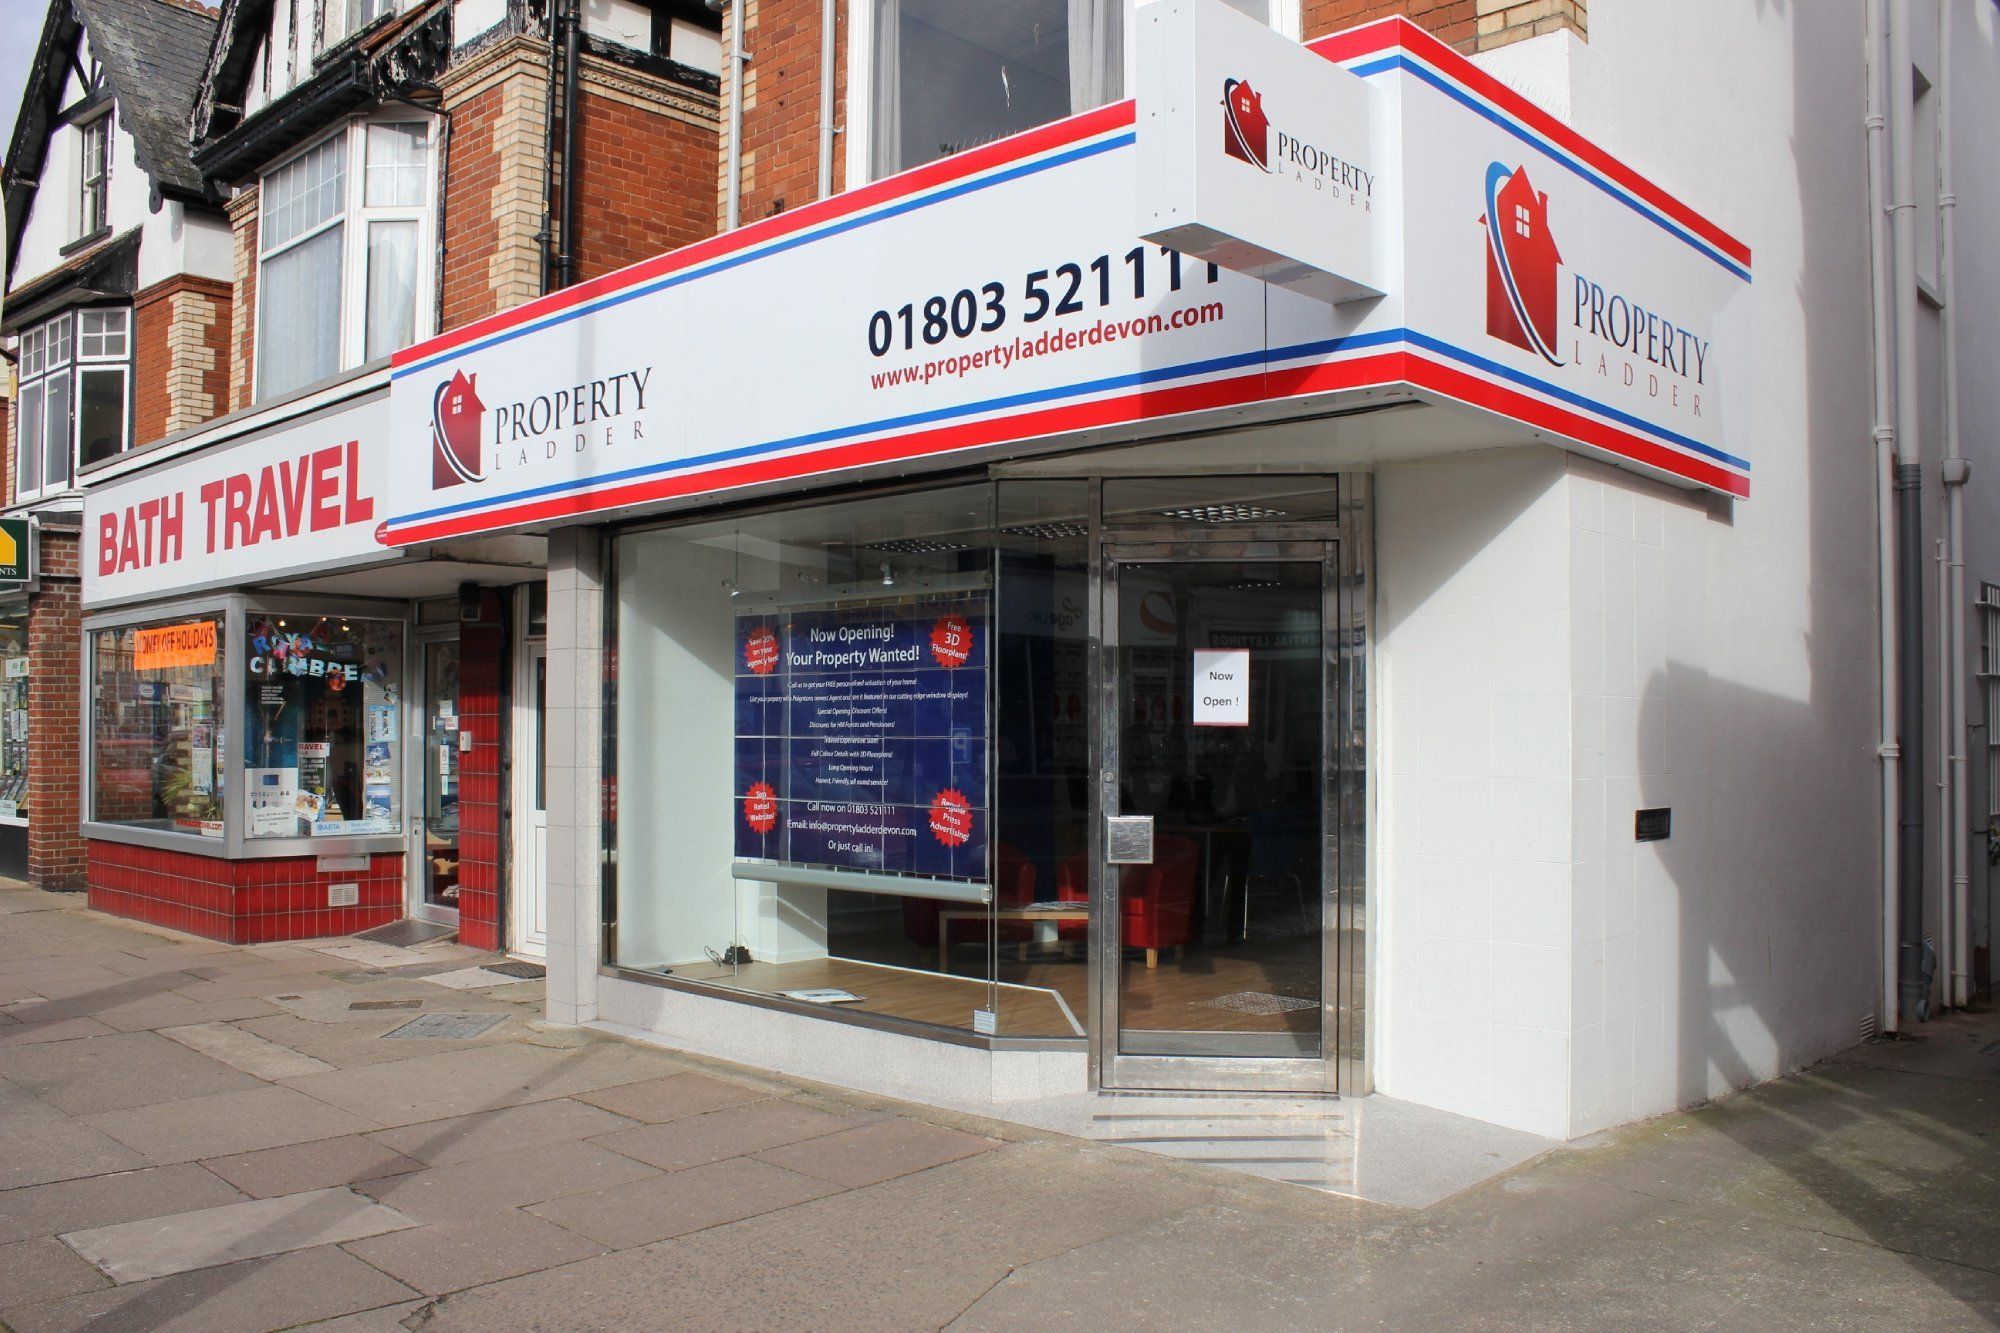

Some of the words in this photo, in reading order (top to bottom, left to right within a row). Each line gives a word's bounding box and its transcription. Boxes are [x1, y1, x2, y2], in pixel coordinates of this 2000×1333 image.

[1278, 131, 1375, 198] PROPERTY
[1278, 162, 1371, 213] LADDER
[868, 281, 1006, 357] 01803
[1573, 272, 1711, 387] PROPERTY
[871, 301, 1224, 390] www.propertyladderdevon.com
[1574, 340, 1702, 417] LADDER
[494, 366, 654, 445] PROPERTY
[495, 420, 645, 471] LADDER
[99, 491, 183, 577] BATH
[200, 440, 374, 553] TRAVEL
[810, 628, 837, 643] Now
[839, 623, 894, 645] Opening!
[947, 621, 962, 632] Free
[136, 634, 161, 654] ONEY
[945, 632, 960, 646] 3D
[786, 652, 813, 666] Your
[815, 650, 866, 668] Property
[868, 645, 920, 663] Wanted!
[932, 643, 968, 660] Floorplans!
[1209, 671, 1233, 681] Now
[1203, 696, 1232, 708] Open
[807, 802, 820, 811] Call
[847, 804, 868, 815] 01803
[943, 812, 960, 826] Press
[930, 821, 970, 842] Advertising!
[828, 840, 837, 850] Or
[837, 841, 850, 852] just
[851, 844, 863, 852] call
